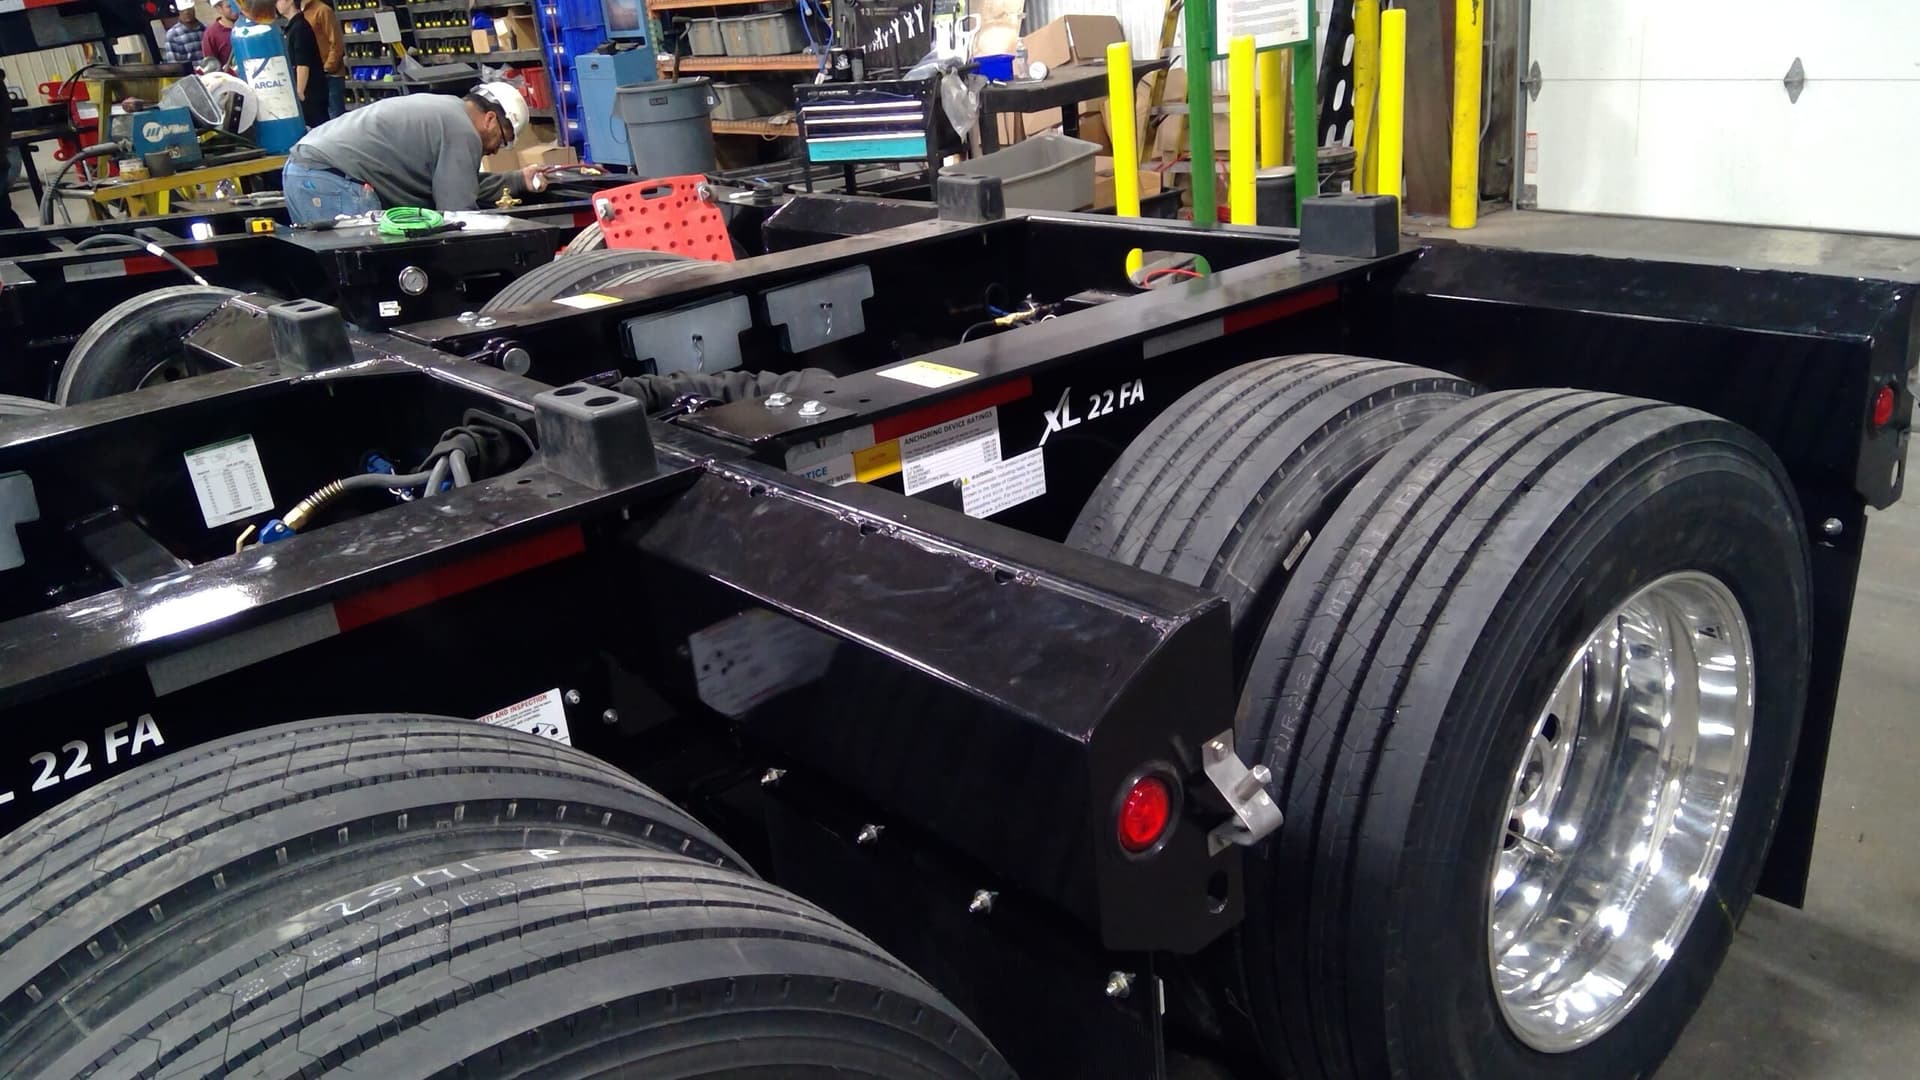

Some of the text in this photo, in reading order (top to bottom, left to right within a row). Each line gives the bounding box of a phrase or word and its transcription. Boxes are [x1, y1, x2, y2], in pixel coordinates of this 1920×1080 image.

[904, 411, 993, 445] ANCHORING DEVICE RATINGS
[1039, 379, 1144, 446] XL 22 FA
[800, 466, 828, 480] TICE
[495, 708, 509, 719] AND
[510, 694, 547, 713] INSPECTION
[29, 713, 165, 792] 22 FA
